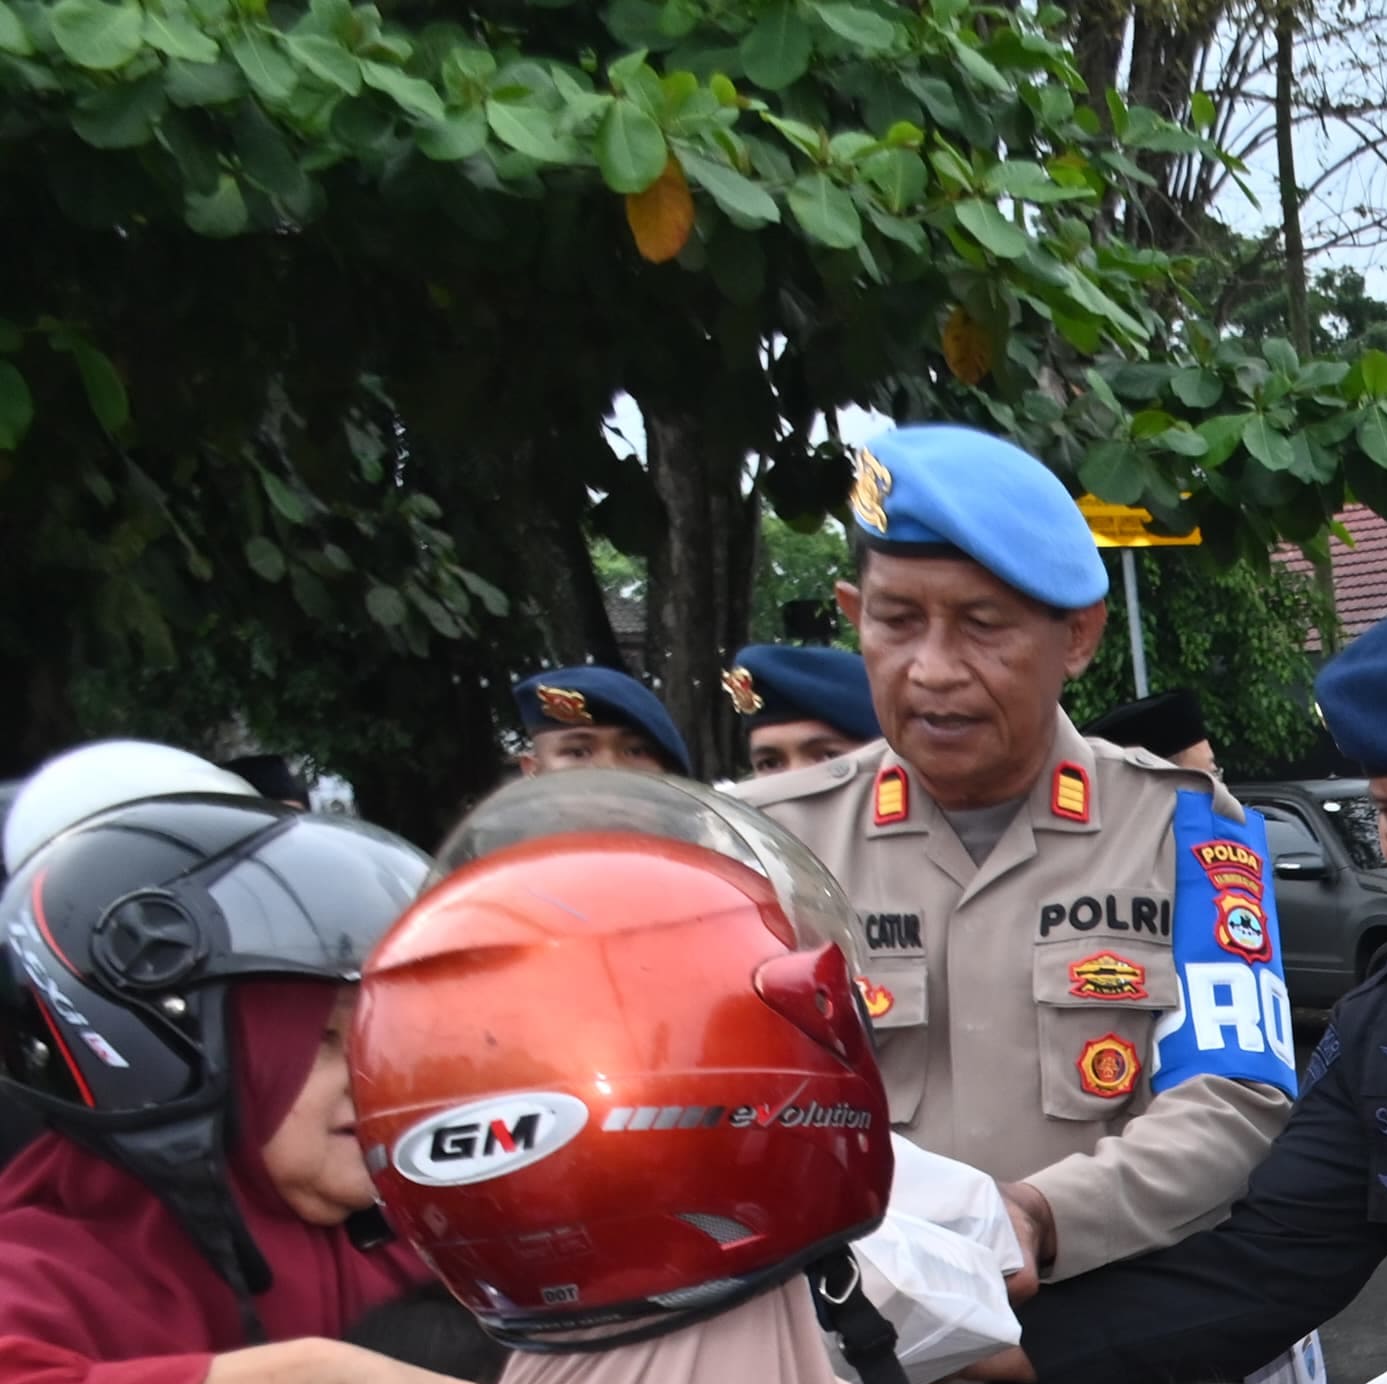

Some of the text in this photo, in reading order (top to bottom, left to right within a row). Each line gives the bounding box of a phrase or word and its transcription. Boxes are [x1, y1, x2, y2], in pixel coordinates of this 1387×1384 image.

[1201, 845, 1259, 871] POLDA
[866, 913, 923, 950] CATUR
[1041, 895, 1171, 937] POLRI
[727, 1096, 872, 1131] evolution
[429, 1112, 541, 1163] GM
[543, 1286, 577, 1303] DOT
